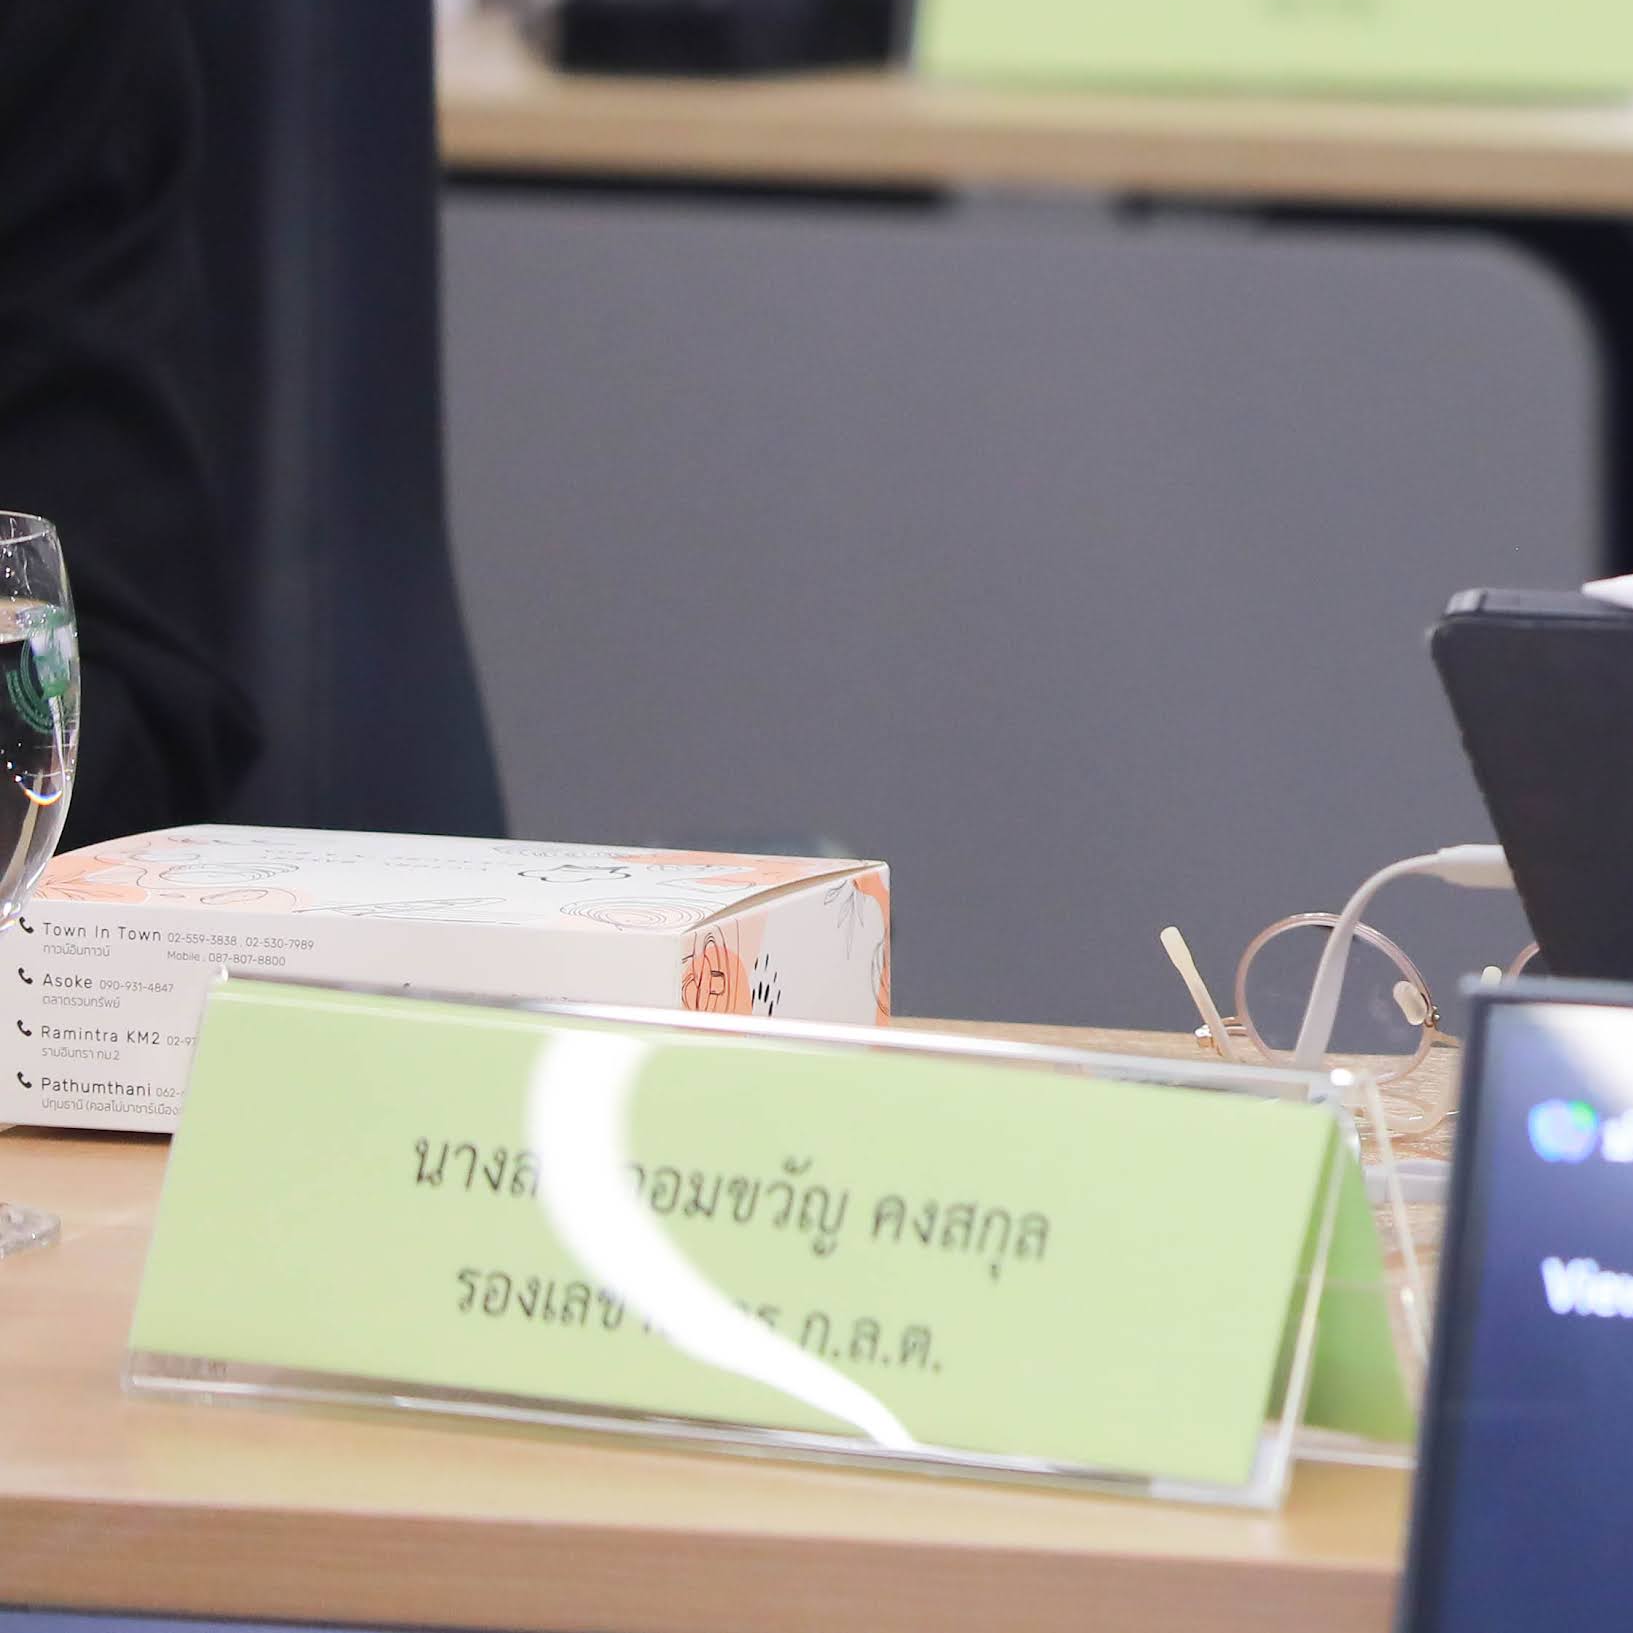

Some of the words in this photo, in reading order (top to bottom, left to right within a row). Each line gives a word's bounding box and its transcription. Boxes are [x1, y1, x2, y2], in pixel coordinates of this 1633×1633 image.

[42, 921, 87, 937] Town
[95, 925, 110, 939] In
[117, 926, 162, 941] Town
[167, 932, 237, 946] 02-559-3838
[245, 936, 315, 951] 02-530-7989
[208, 952, 286, 967] 087-807-8800
[42, 973, 93, 989] Asoke
[99, 979, 174, 993] 090-931-4847
[41, 1025, 119, 1043] Ramintra
[126, 1030, 161, 1046] KM2
[41, 1077, 152, 1097] Pathumthani
[870, 1193, 1051, 1282] คงสกุล
